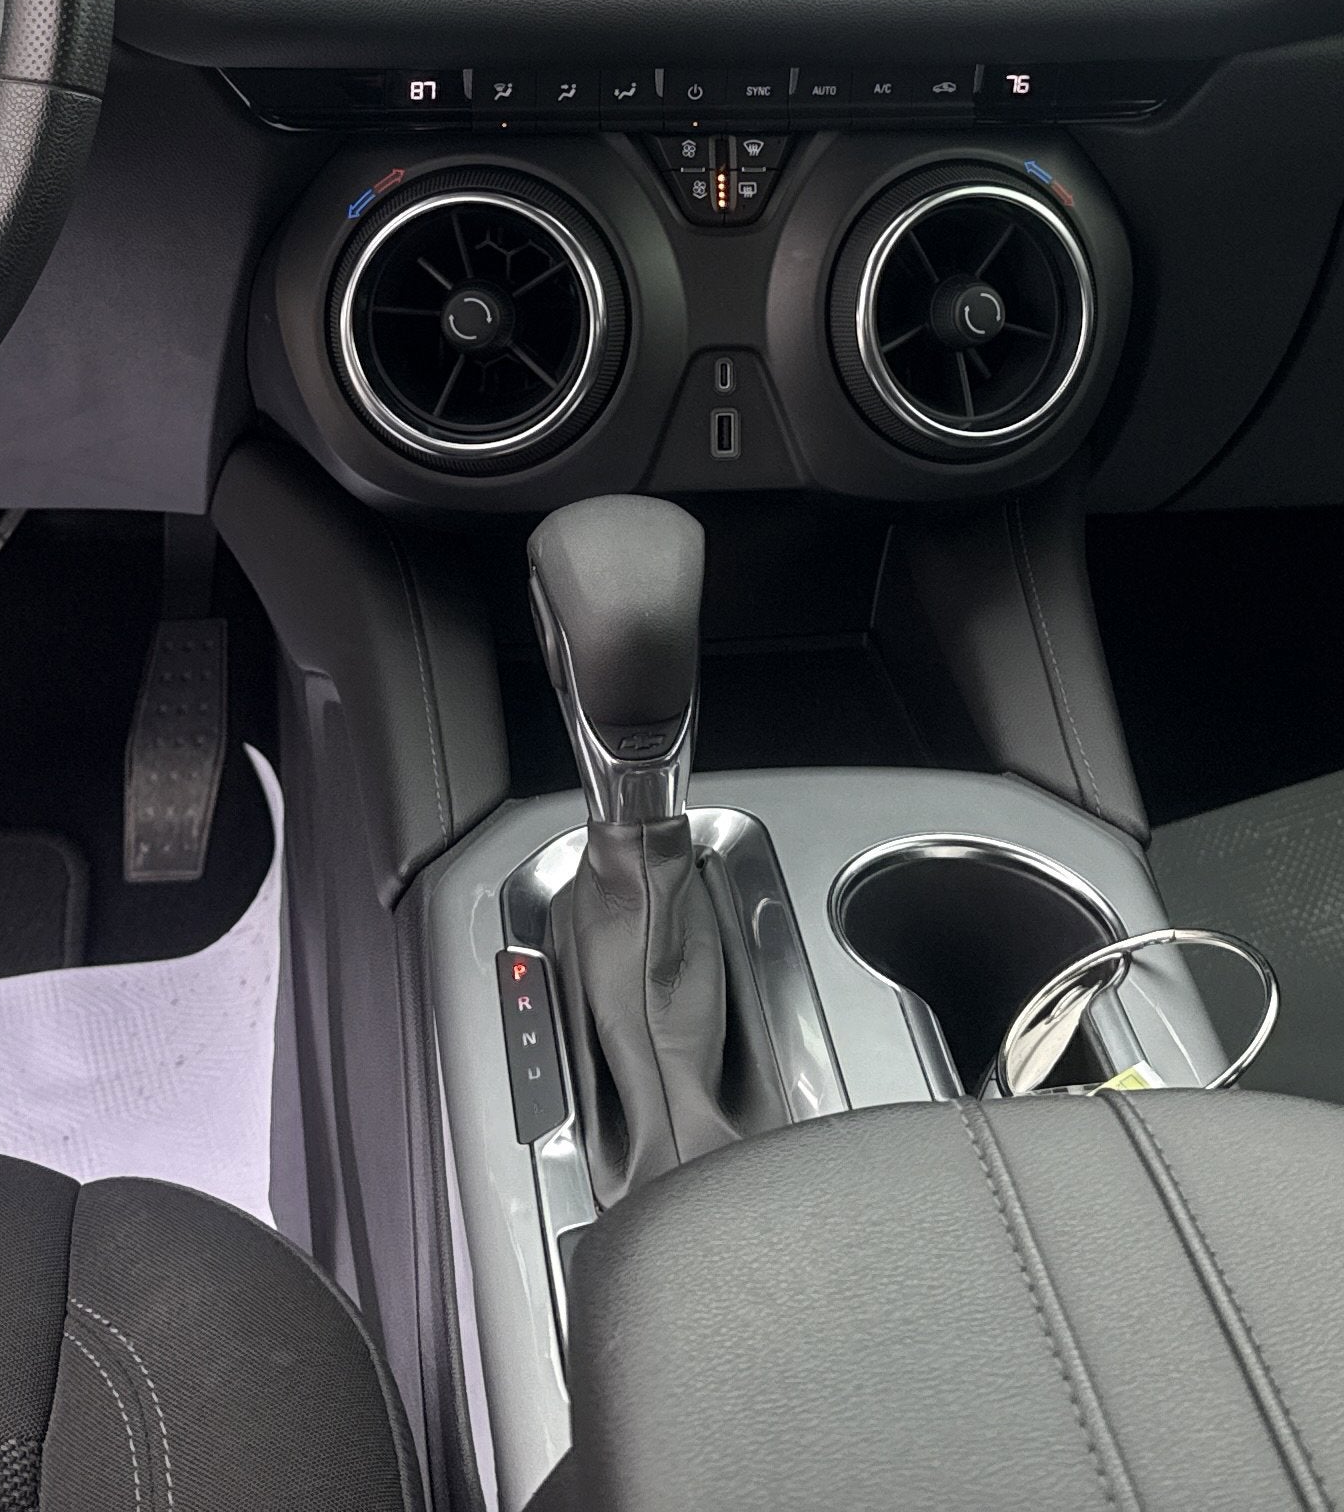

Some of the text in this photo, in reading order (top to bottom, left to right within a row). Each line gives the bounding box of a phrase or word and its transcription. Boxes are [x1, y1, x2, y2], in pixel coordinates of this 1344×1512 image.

[410, 80, 437, 101] 87
[746, 85, 772, 97] SYNC
[812, 85, 837, 96] AUTO
[874, 83, 892, 94] A/C
[513, 964, 526, 980] P
[518, 996, 532, 1012] R
[522, 1031, 537, 1046] N
